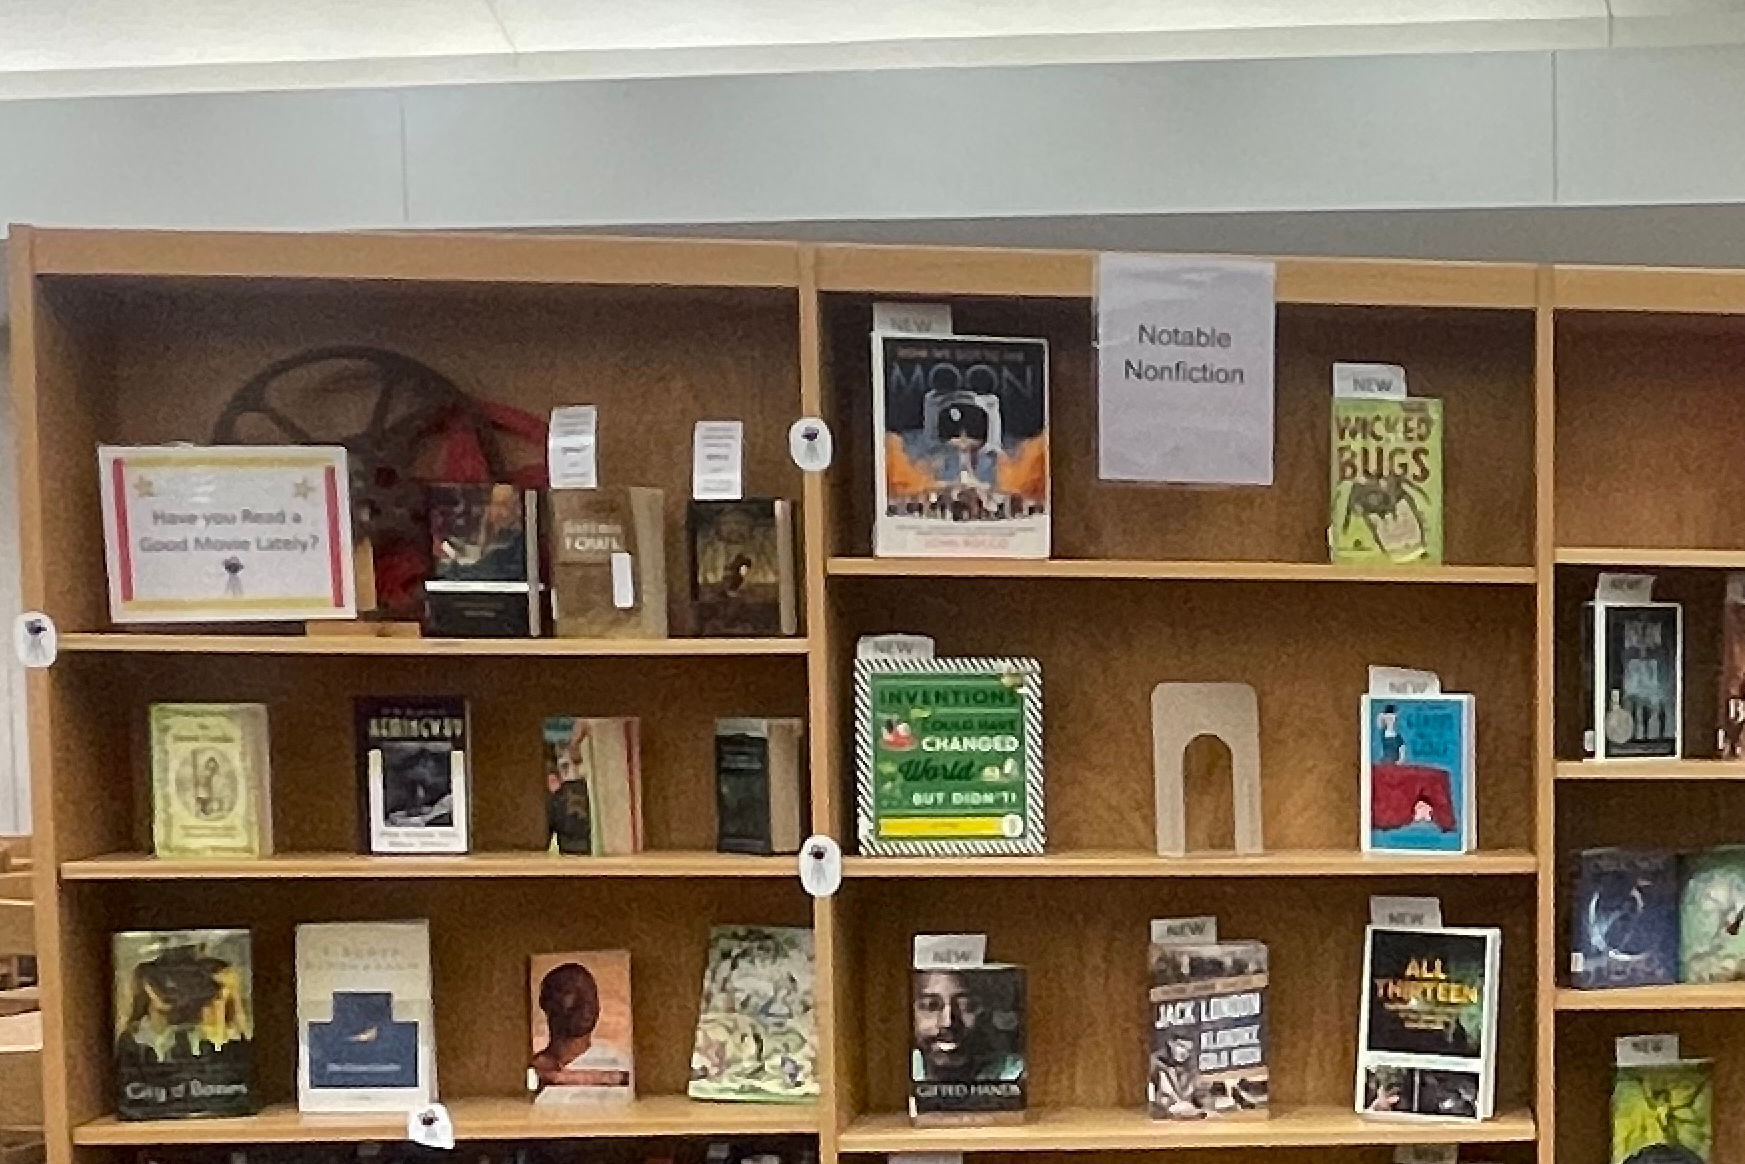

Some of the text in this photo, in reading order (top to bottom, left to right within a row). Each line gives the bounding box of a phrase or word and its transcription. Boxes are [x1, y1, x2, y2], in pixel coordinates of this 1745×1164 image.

[1138, 324, 1232, 348] Notable
[890, 362, 1035, 399] MOON
[1124, 358, 1244, 385] Nonfiction
[1353, 377, 1393, 392] NEW
[1335, 415, 1435, 442] WICKED
[1339, 447, 1431, 482] BUGS
[152, 509, 302, 528] Have you Read a
[138, 536, 188, 551] Good
[256, 535, 320, 553] Lately?
[872, 640, 914, 654] NEW
[900, 757, 975, 782] World
[912, 792, 945, 806] BUT
[1167, 923, 1206, 936] NEW
[1388, 912, 1425, 925] NEW
[932, 949, 971, 963] NEW
[1405, 957, 1447, 979] ALL
[1374, 978, 1478, 1004] THIRTEEN
[1155, 1000, 1196, 1029] JACK
[125, 1081, 166, 1103] City
[190, 1079, 249, 1098] Bones
[916, 1084, 1021, 1097] GIFTED HANDS
